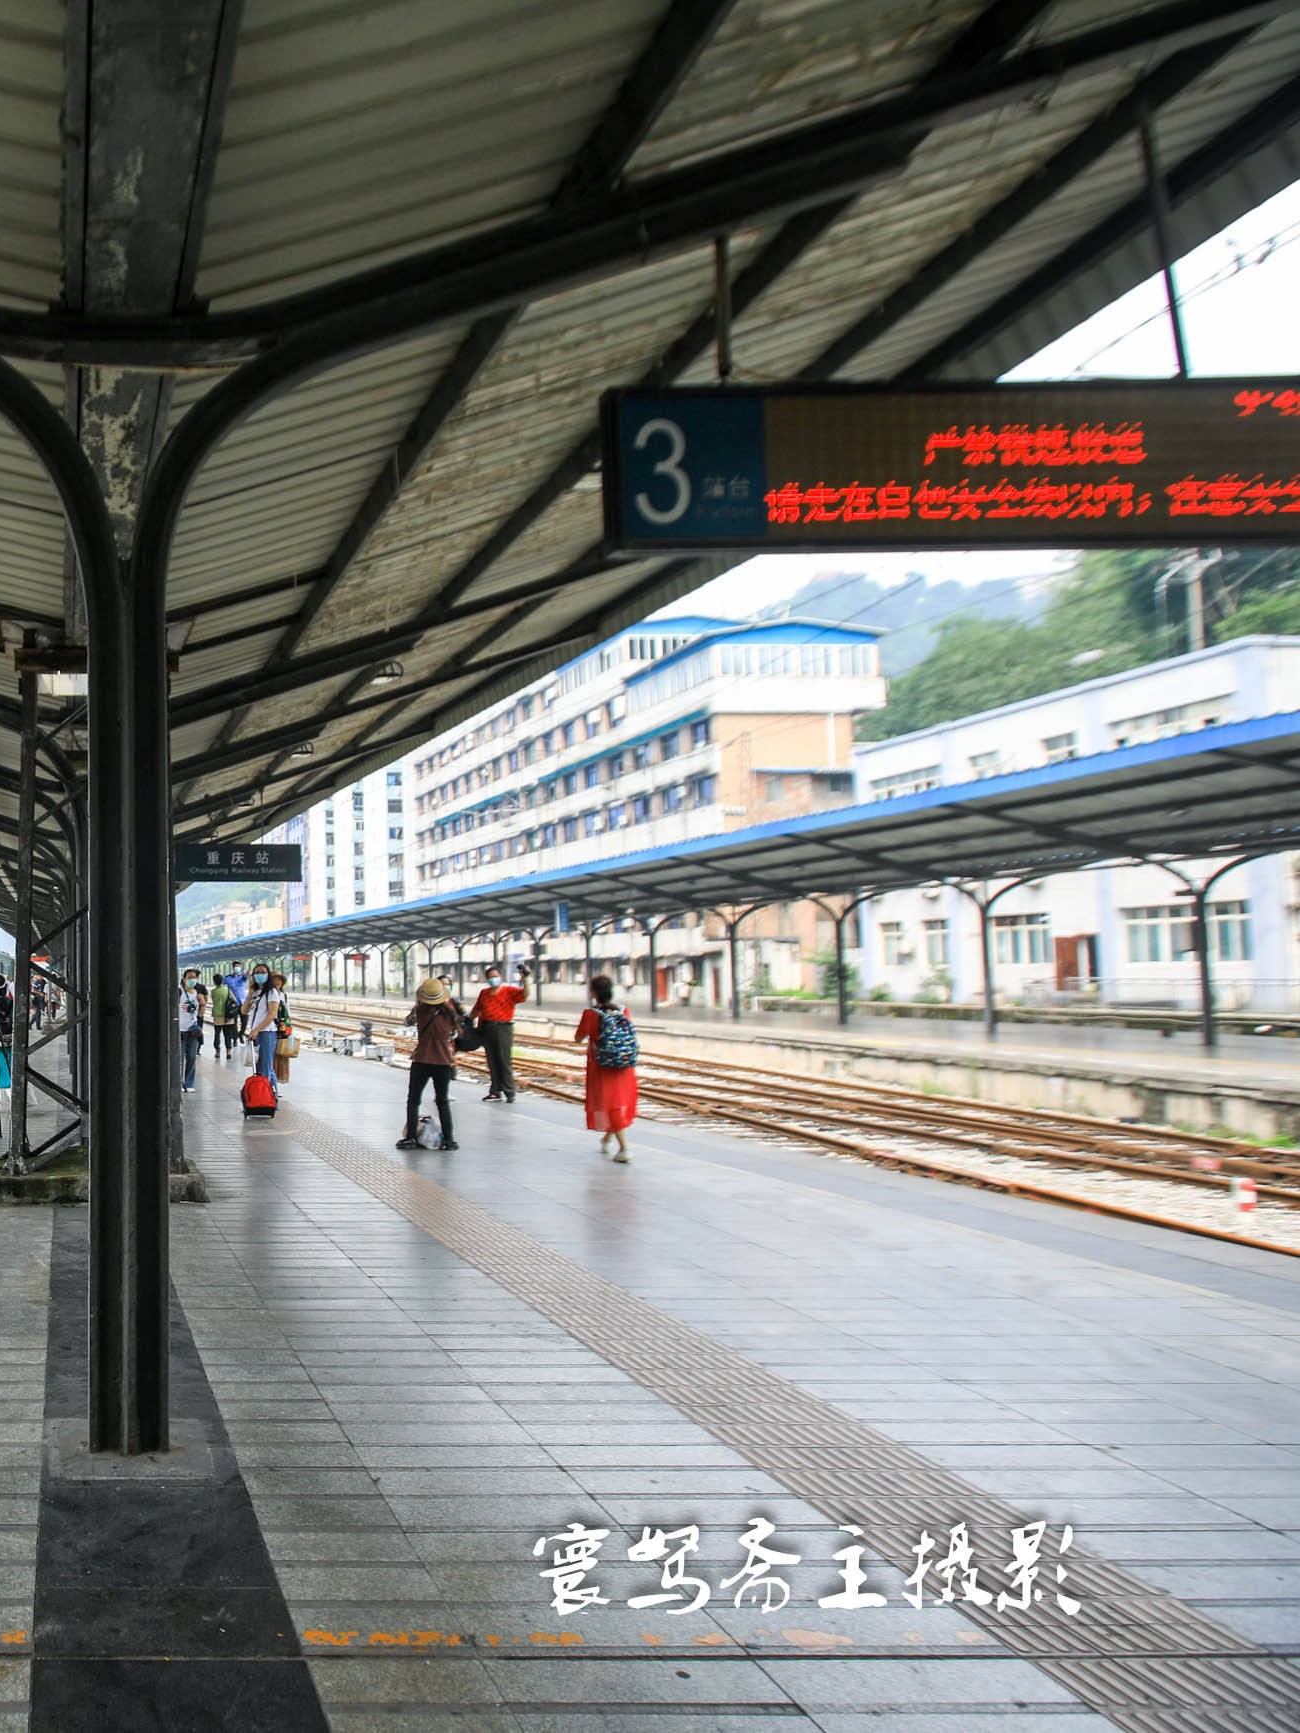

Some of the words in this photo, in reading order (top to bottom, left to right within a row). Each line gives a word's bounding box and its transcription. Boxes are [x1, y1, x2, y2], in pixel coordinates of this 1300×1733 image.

[634, 418, 691, 525] 3
[206, 851, 269, 865] 重庆站
